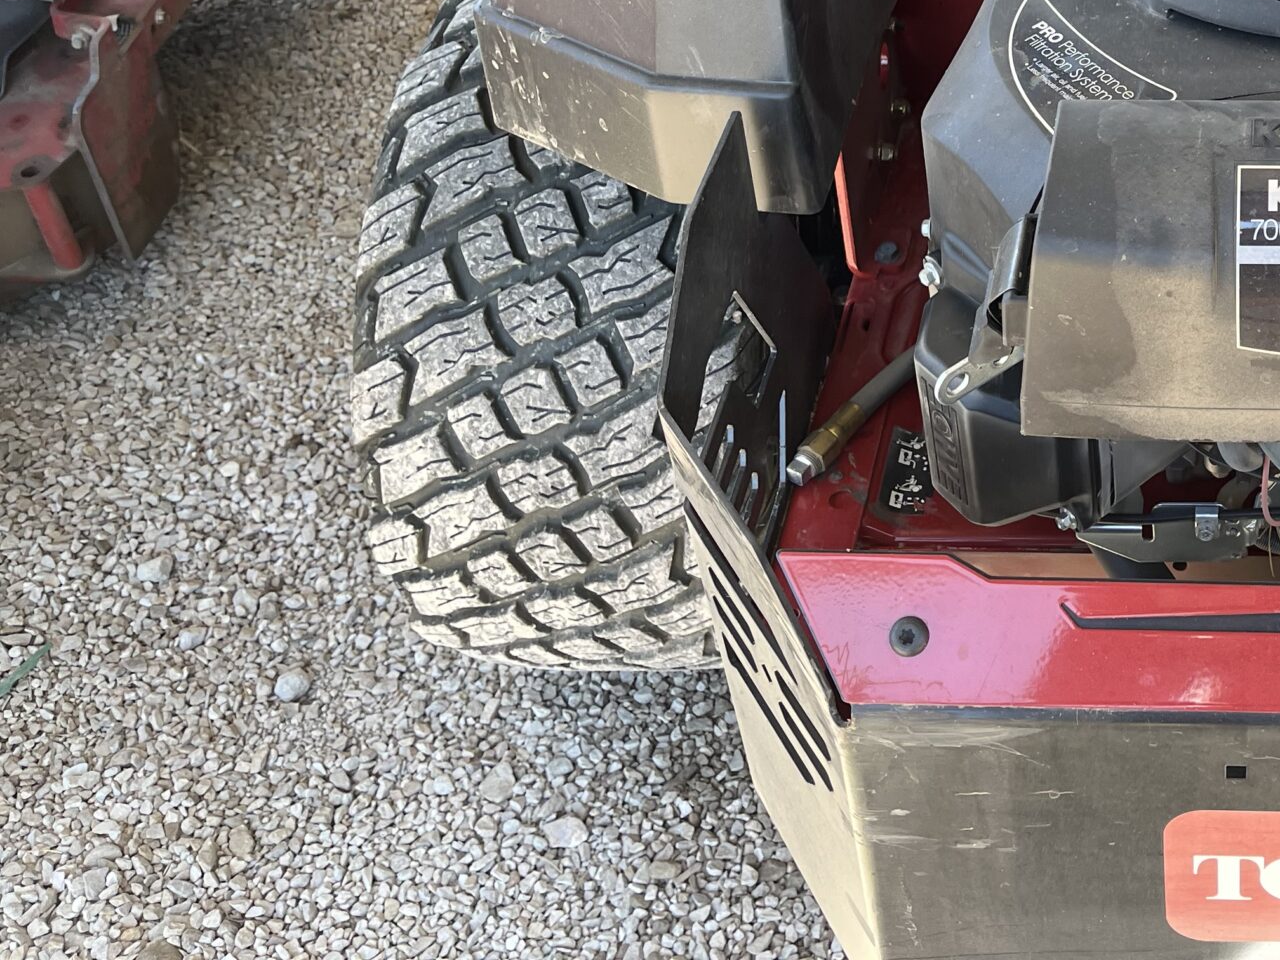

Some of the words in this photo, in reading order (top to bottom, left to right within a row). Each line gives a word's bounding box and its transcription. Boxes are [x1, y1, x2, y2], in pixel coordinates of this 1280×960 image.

[1024, 33, 1072, 72] Filtration
[1069, 68, 1113, 101] System
[1031, 20, 1064, 43] PRO
[1058, 40, 1135, 100] Performance
